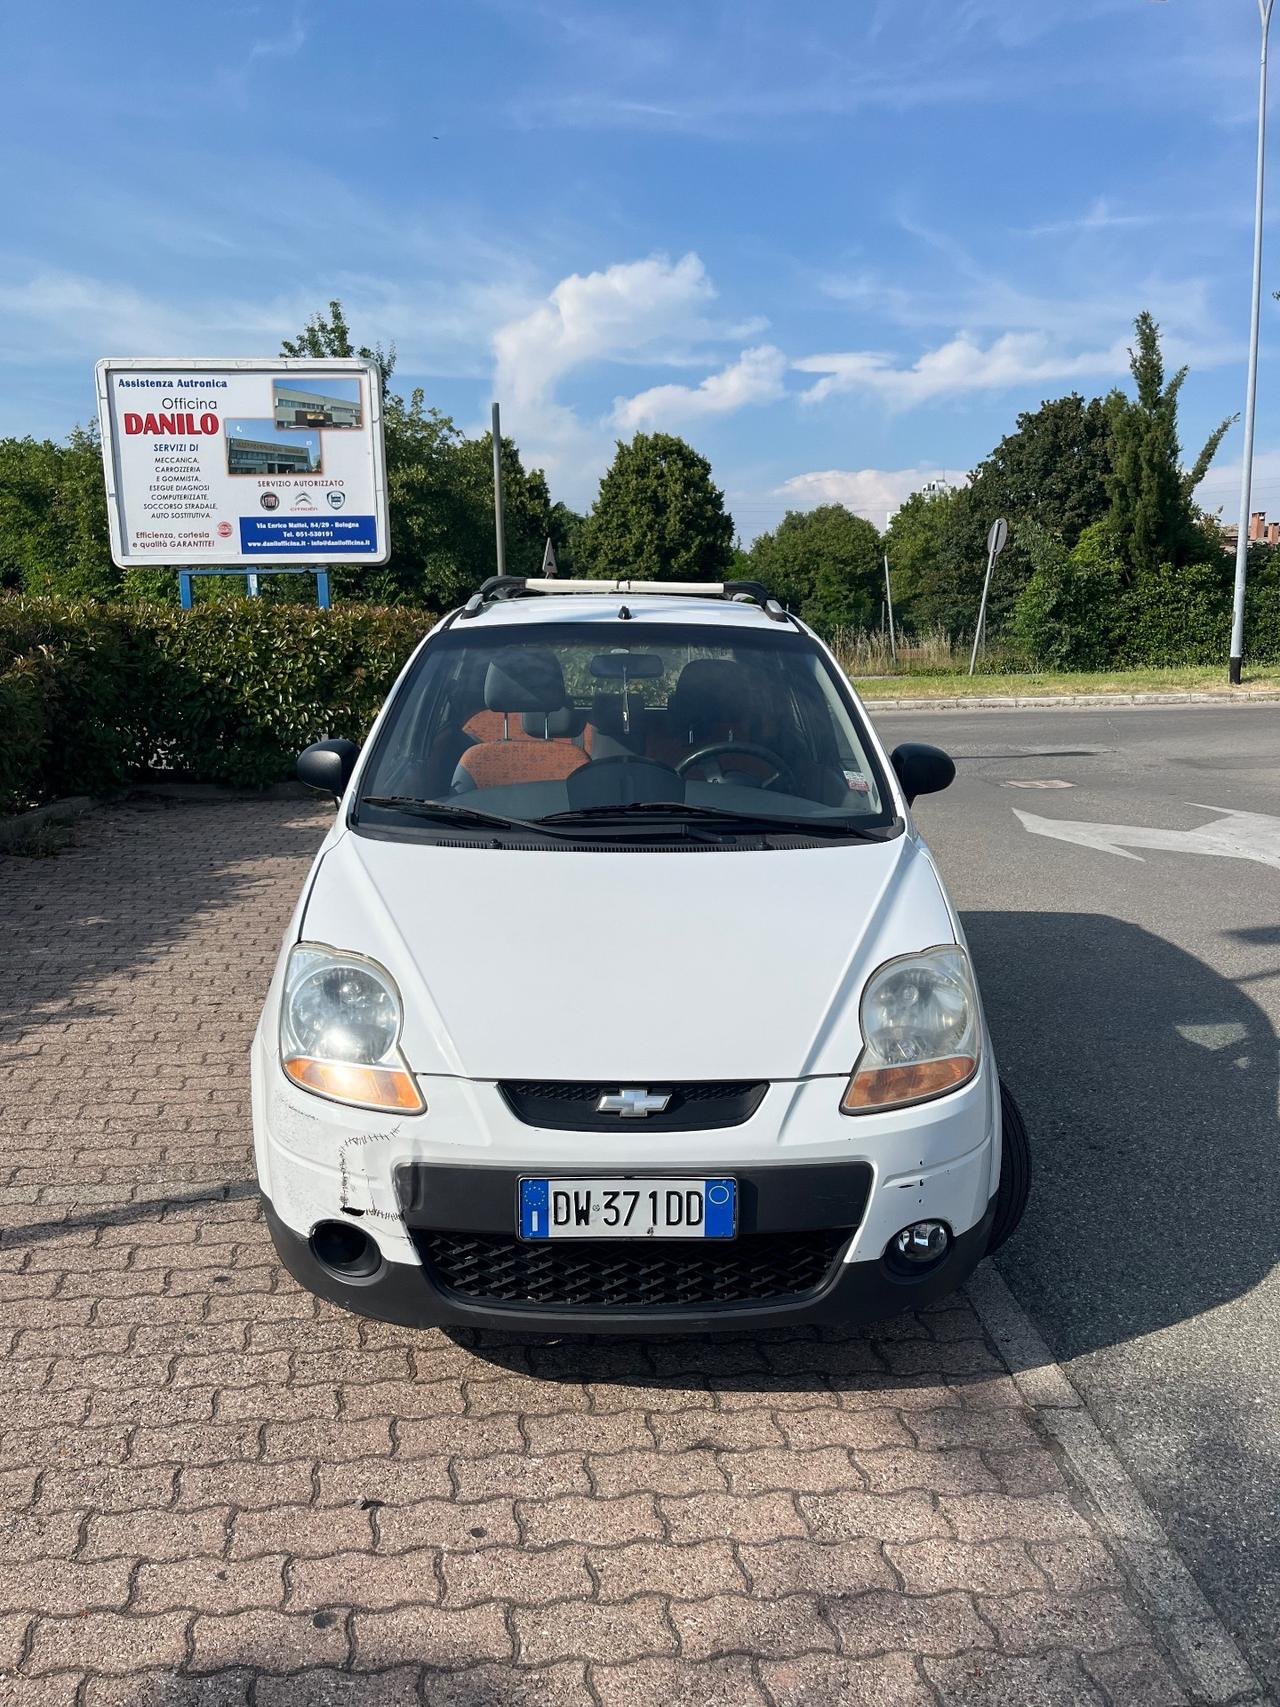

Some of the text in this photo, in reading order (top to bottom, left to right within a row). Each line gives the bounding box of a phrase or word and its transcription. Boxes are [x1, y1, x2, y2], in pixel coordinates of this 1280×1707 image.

[118, 379, 228, 388] Assistenza Autronica
[161, 397, 217, 410] Officina
[124, 413, 219, 435] DANILO
[153, 443, 199, 452] SERVIZI DI
[257, 480, 291, 488] SERVIZIO
[135, 531, 210, 540] Efficienza, cortesia
